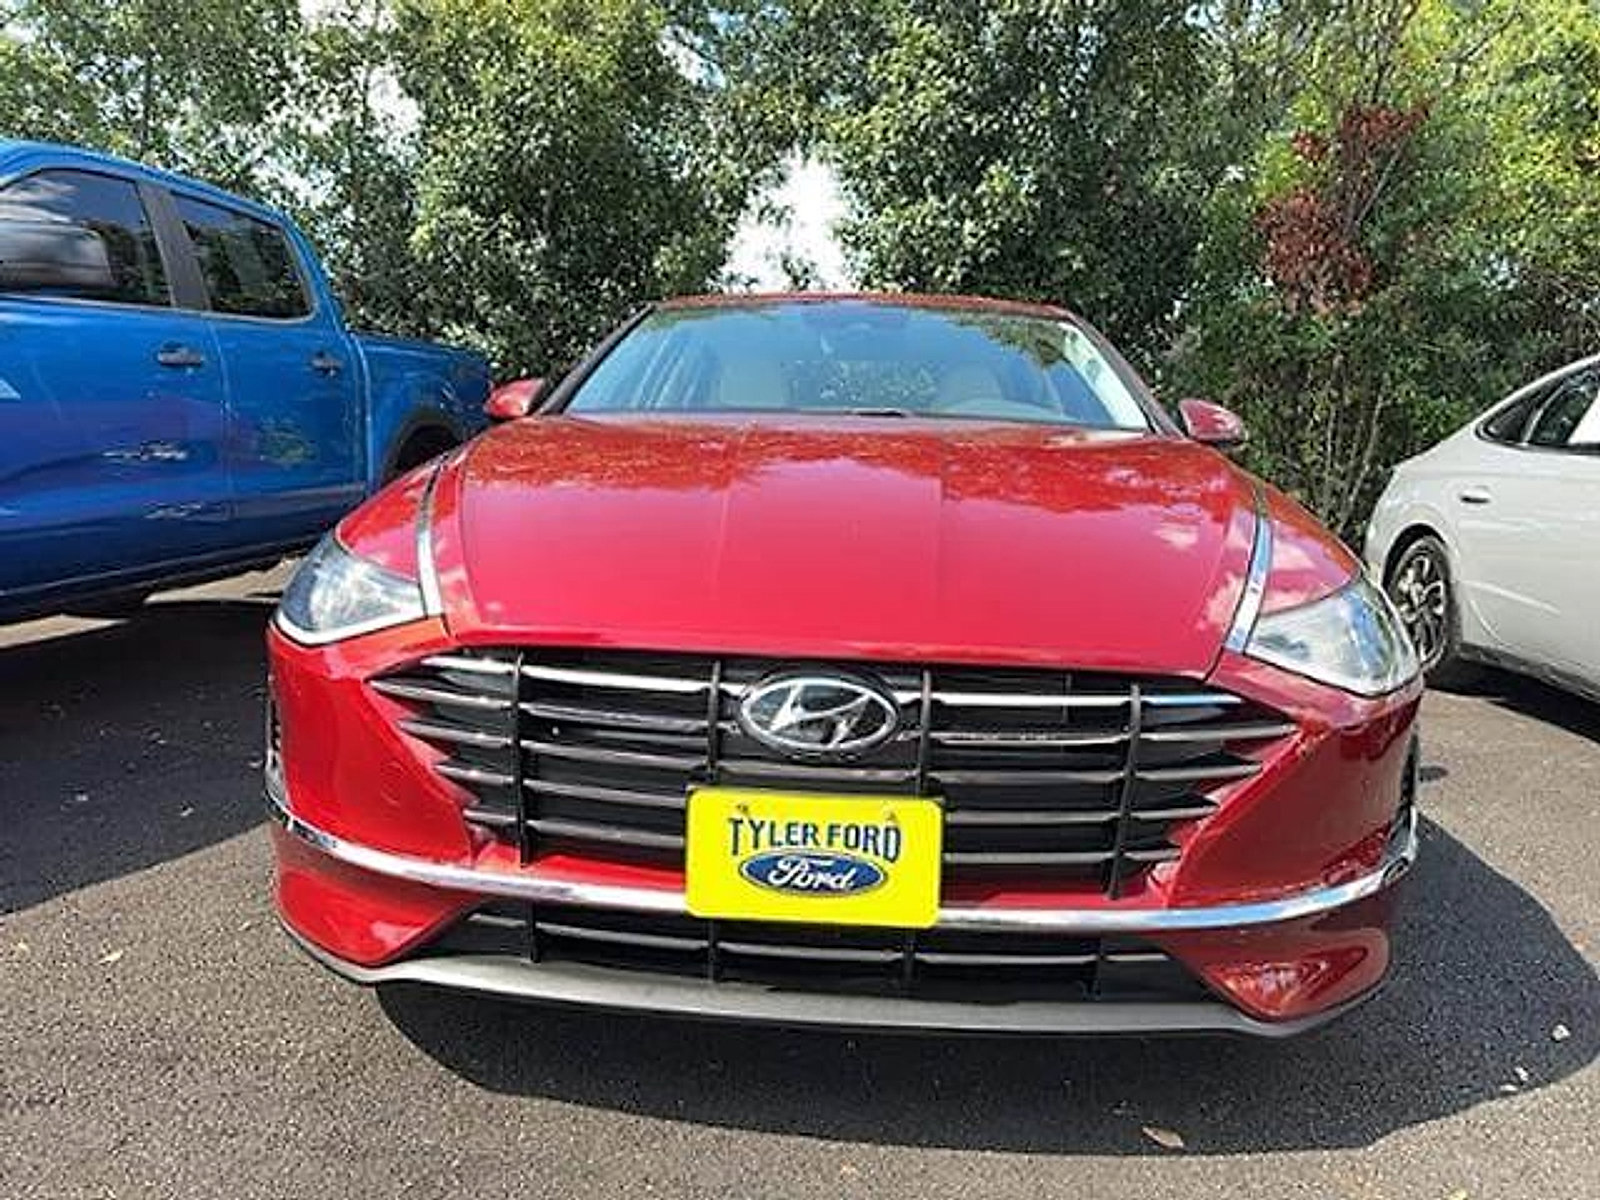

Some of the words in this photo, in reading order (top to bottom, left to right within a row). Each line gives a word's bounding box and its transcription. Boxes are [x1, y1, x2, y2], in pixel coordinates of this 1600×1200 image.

[729, 817, 820, 856] TYLER
[827, 822, 902, 864] FORD
[768, 857, 856, 890] Ford
